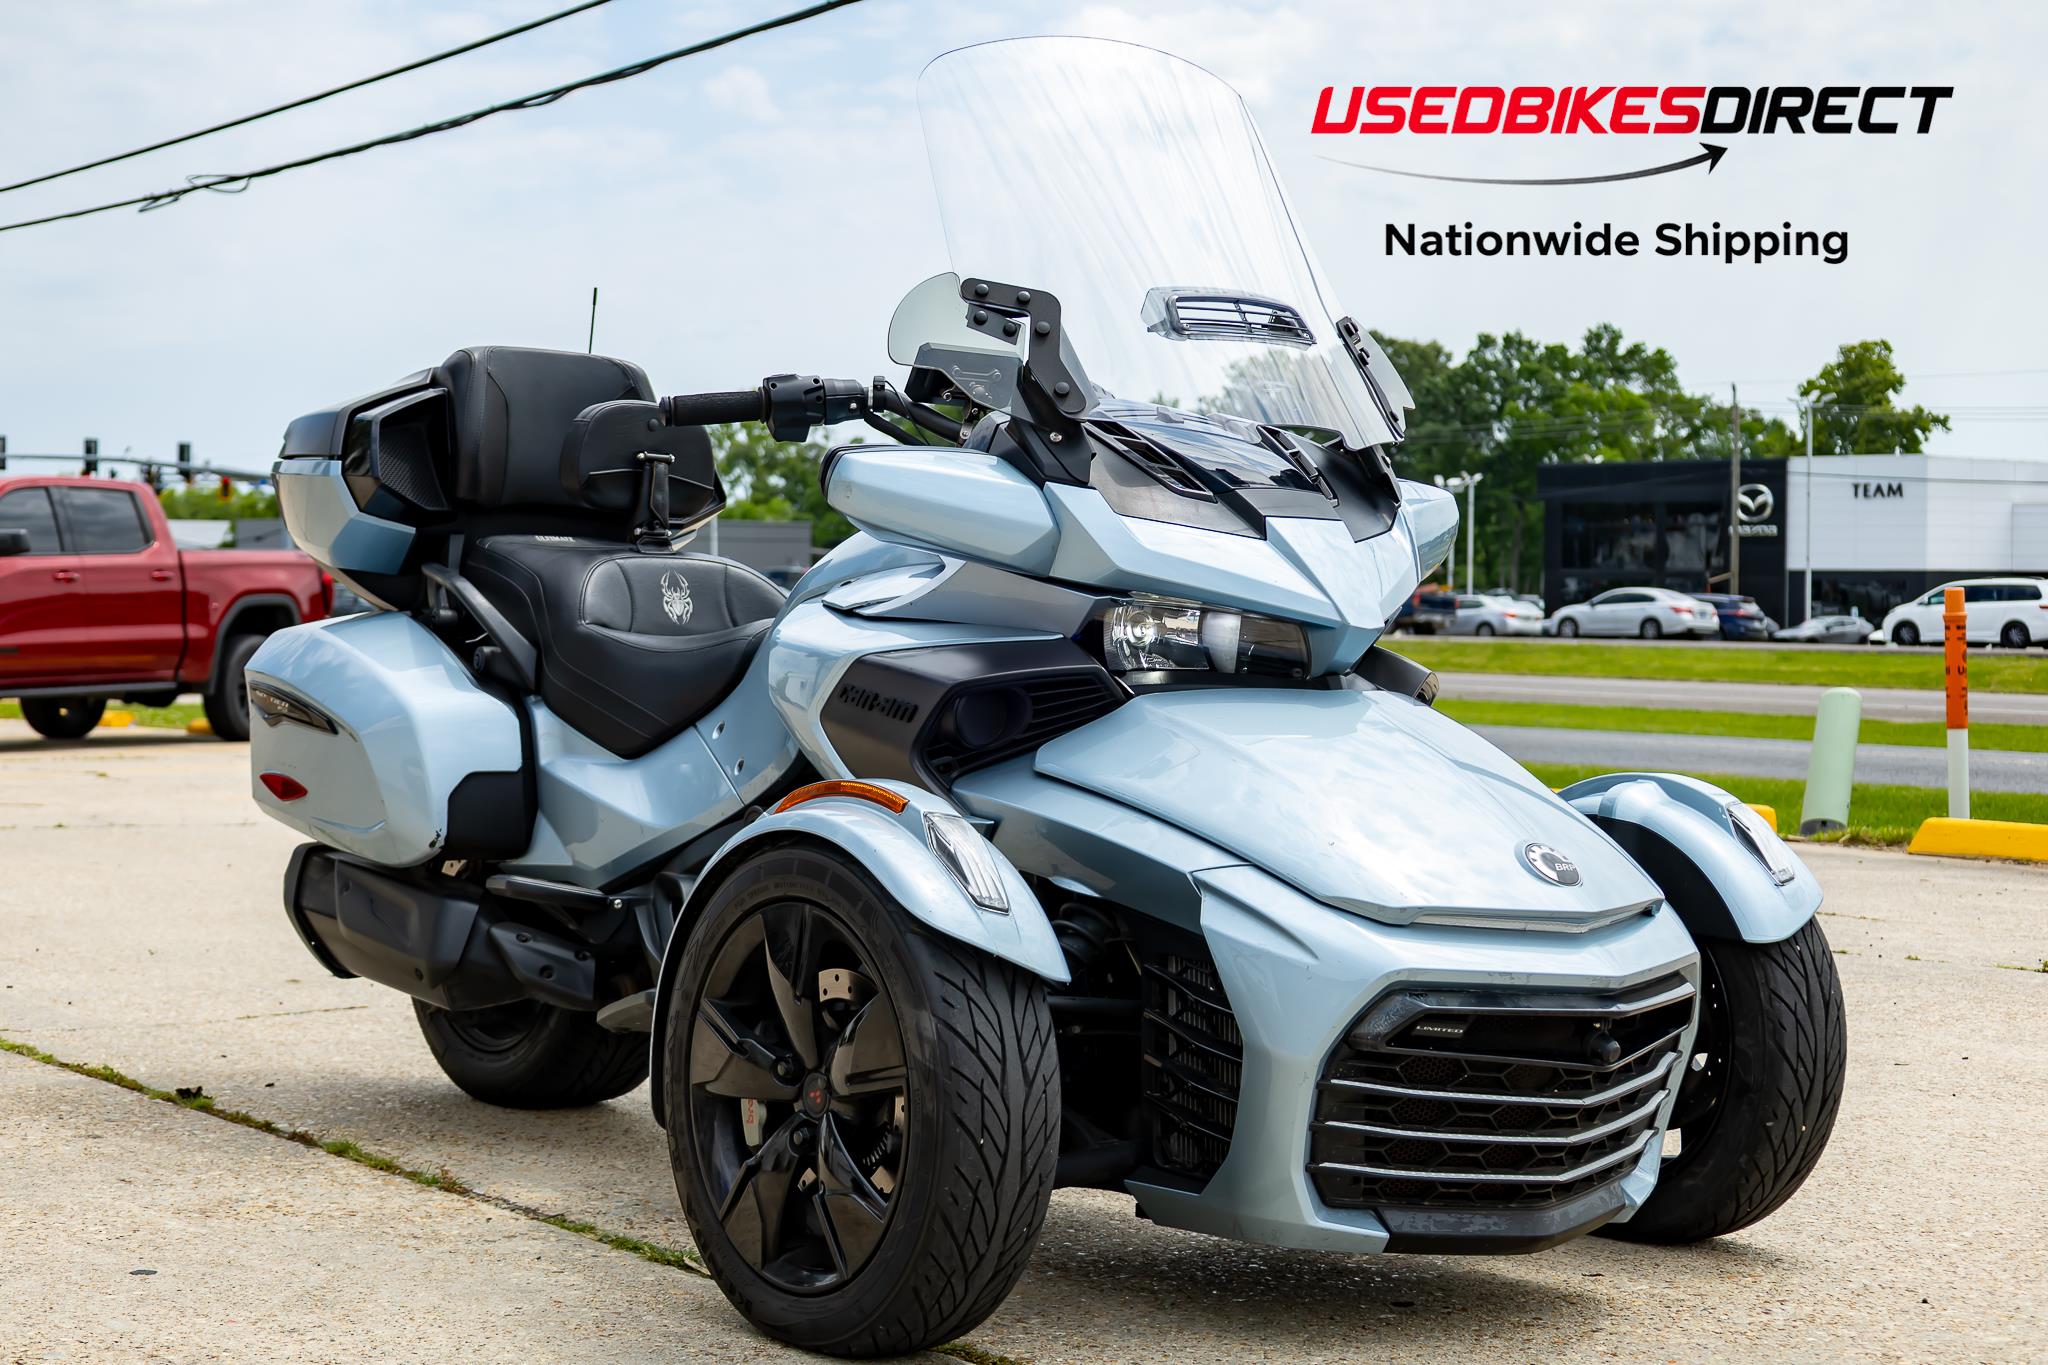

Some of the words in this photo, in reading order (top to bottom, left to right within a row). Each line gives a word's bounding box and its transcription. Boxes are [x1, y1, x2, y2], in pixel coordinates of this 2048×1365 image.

[1851, 482, 1904, 499] TEAM
[1555, 862, 1577, 872] BRP
[1415, 1025, 1464, 1034] LIMITED
